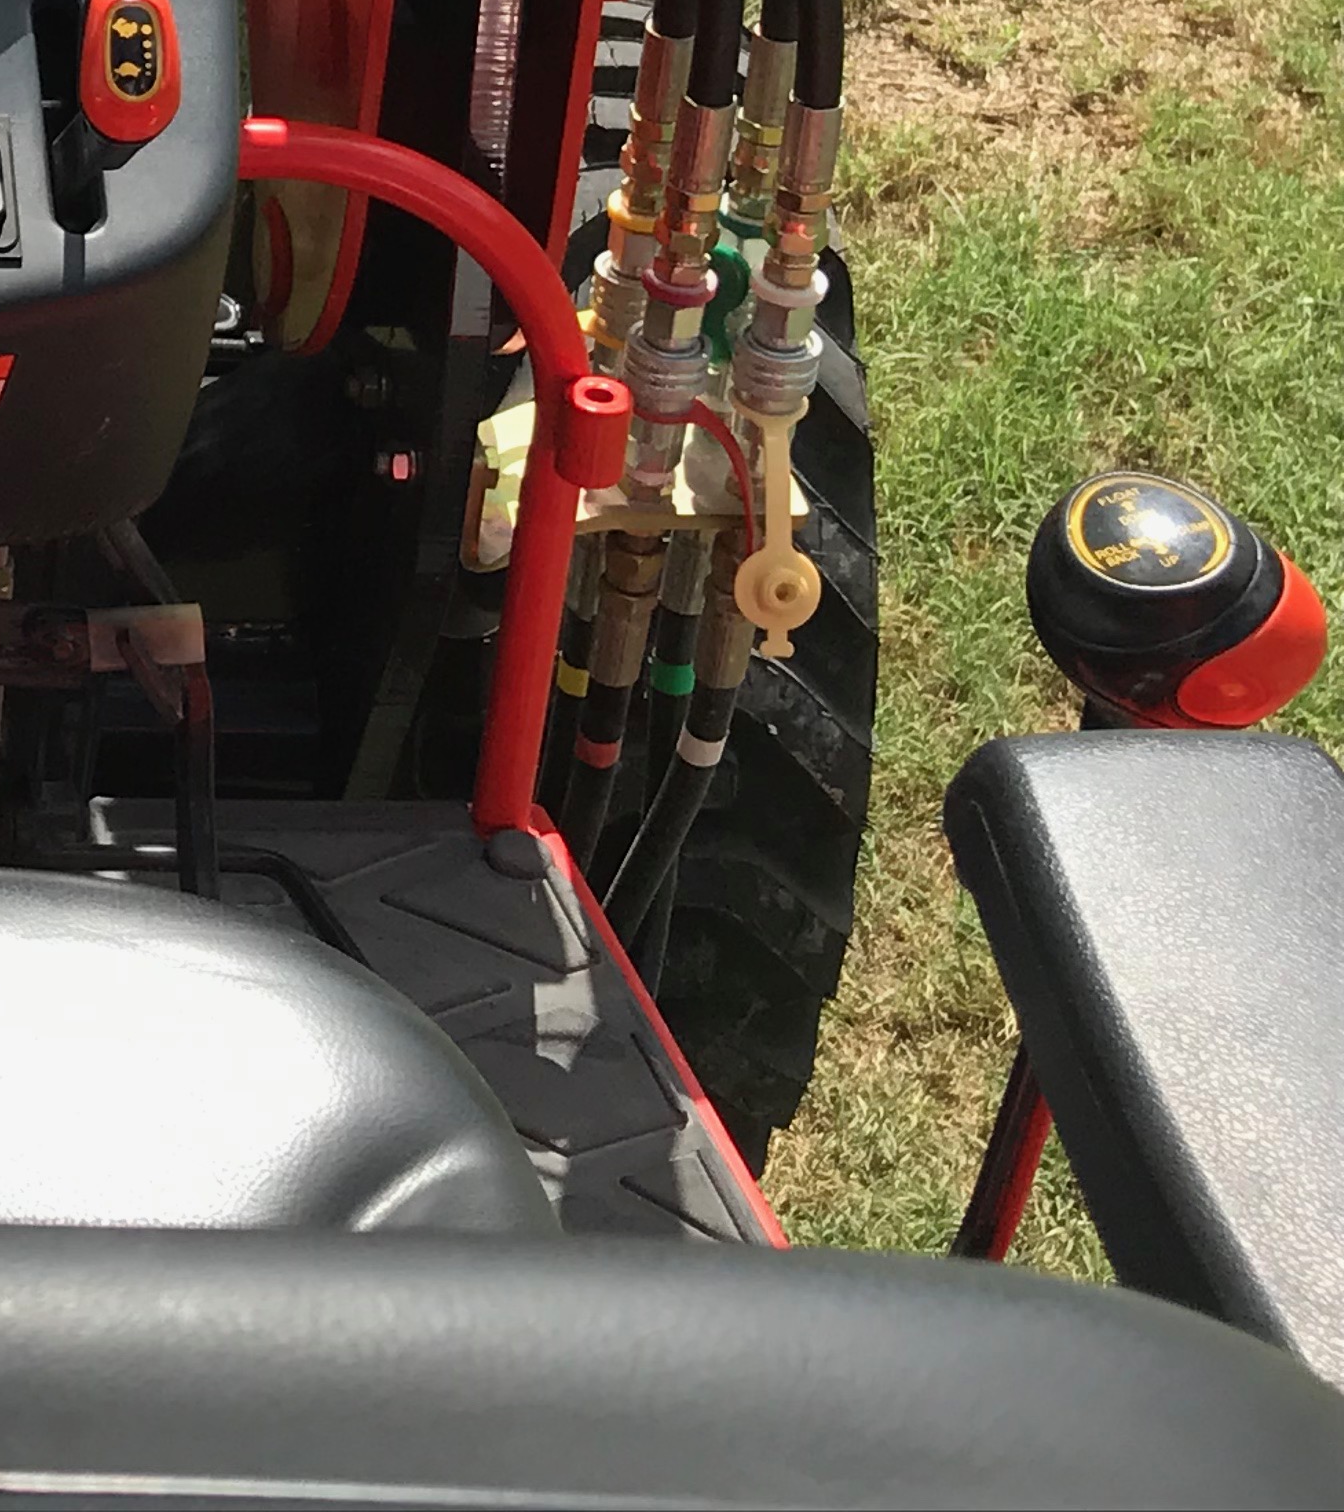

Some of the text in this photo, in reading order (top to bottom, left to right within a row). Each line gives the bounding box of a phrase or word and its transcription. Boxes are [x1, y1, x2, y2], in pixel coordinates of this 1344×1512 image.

[1097, 487, 1140, 506] FLOAT
[1094, 542, 1130, 560] ROLL
[1105, 549, 1141, 567] BACK
[1158, 553, 1180, 568] UP
